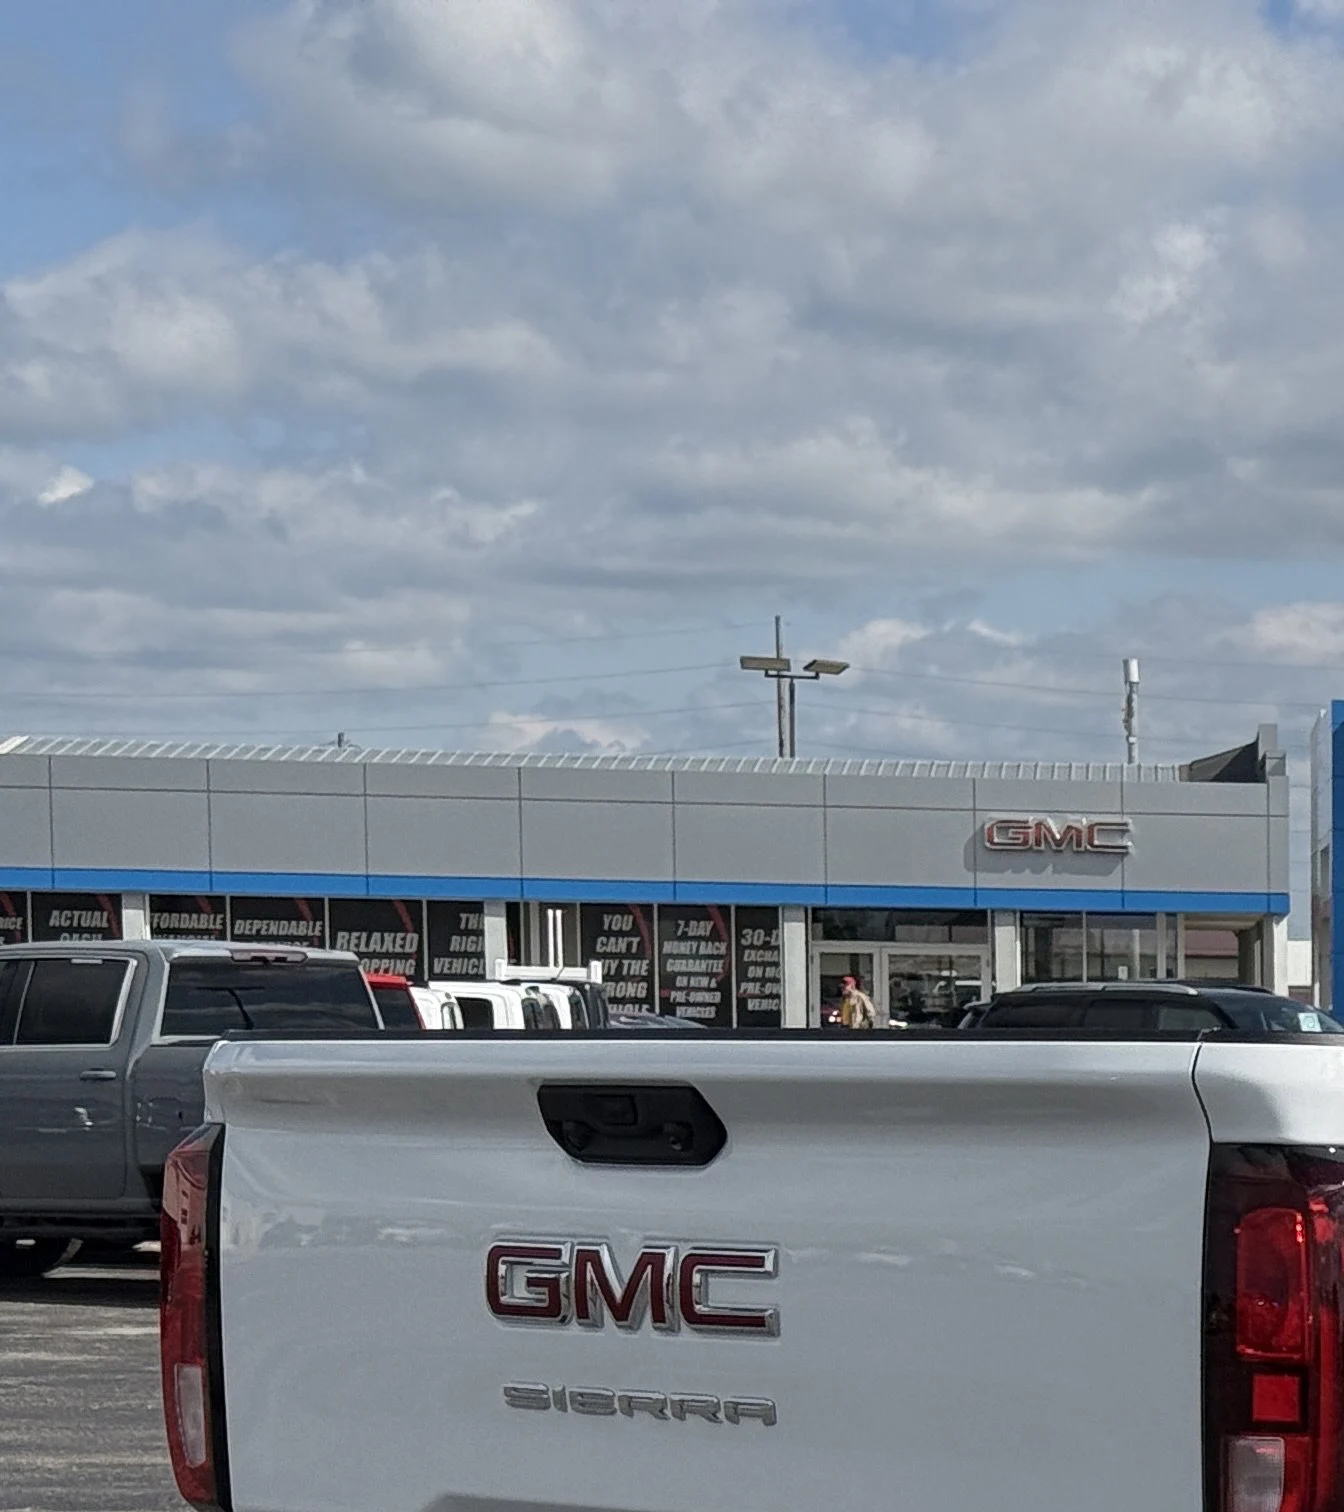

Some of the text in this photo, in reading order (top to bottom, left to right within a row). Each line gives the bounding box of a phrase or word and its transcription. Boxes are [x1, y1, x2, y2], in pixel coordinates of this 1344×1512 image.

[985, 817, 1133, 855] GMC
[0, 916, 23, 930] RICE
[49, 910, 110, 928] ACTUAL
[151, 912, 224, 930] FORDABLE
[233, 919, 323, 937] DEPENDABLE
[603, 914, 634, 931] YOU
[676, 920, 715, 937] 7-DAY
[740, 928, 780, 946] 30-D
[335, 931, 420, 953] RELAXED
[450, 935, 485, 953] RIG
[596, 937, 641, 953] CAN'T
[662, 941, 728, 955] MONEY BACK
[743, 949, 780, 962] EXCHA
[360, 958, 417, 976] OPPING
[433, 957, 485, 975] VEHICL
[621, 959, 650, 976] THE
[666, 959, 724, 973] GUARANTEE
[602, 981, 649, 998] RONG
[747, 998, 781, 1011] VEHIC
[486, 1241, 781, 1338] GMC
[503, 1381, 778, 1426] SIERRA
